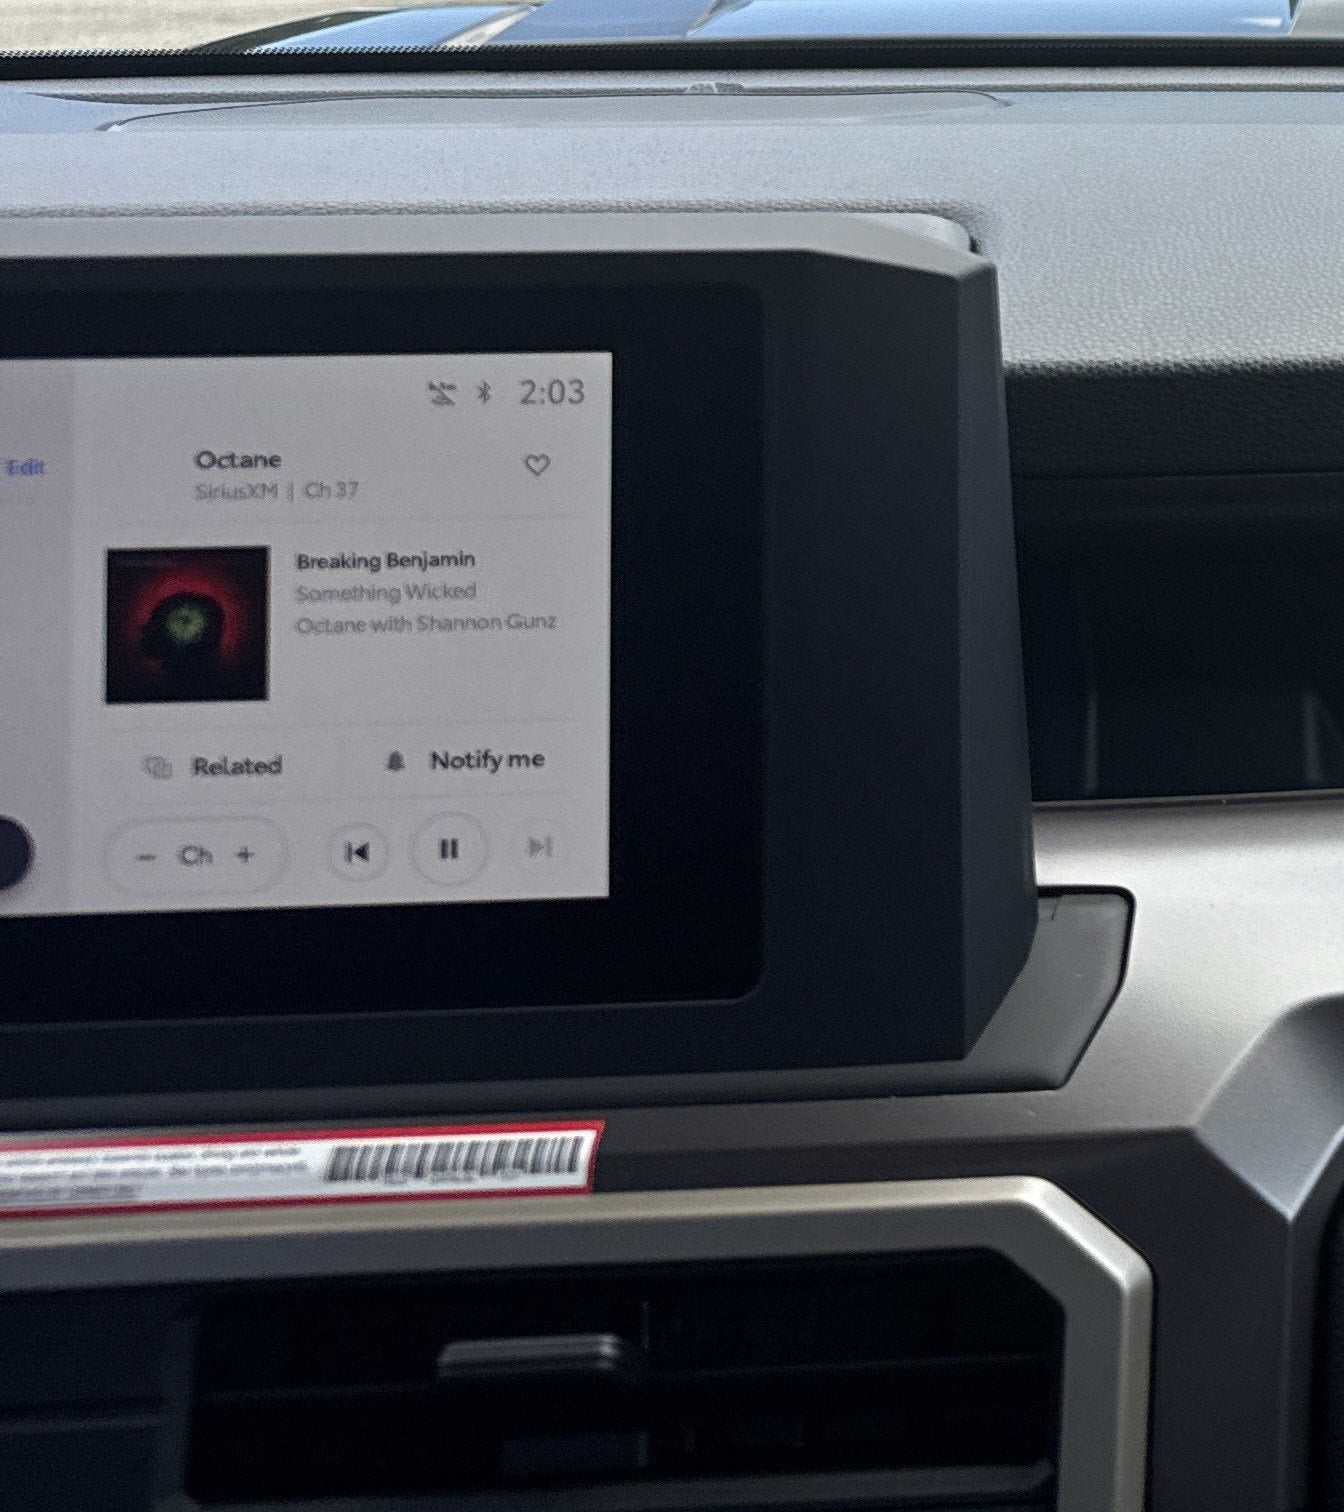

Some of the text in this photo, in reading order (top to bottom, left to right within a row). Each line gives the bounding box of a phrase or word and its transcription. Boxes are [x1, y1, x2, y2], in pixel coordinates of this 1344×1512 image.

[519, 379, 585, 405] 2:03
[195, 450, 282, 469] Octane
[194, 483, 278, 501] SiriusXM
[305, 482, 331, 499] Ch
[335, 481, 359, 499] 37
[297, 551, 475, 573] Breaking Benjamin
[296, 582, 476, 604] Something Wicked
[296, 613, 557, 634] Octane with Shannon Gunz
[191, 755, 283, 777] Related
[429, 750, 546, 773] Notify me
[177, 845, 213, 866] Ch
